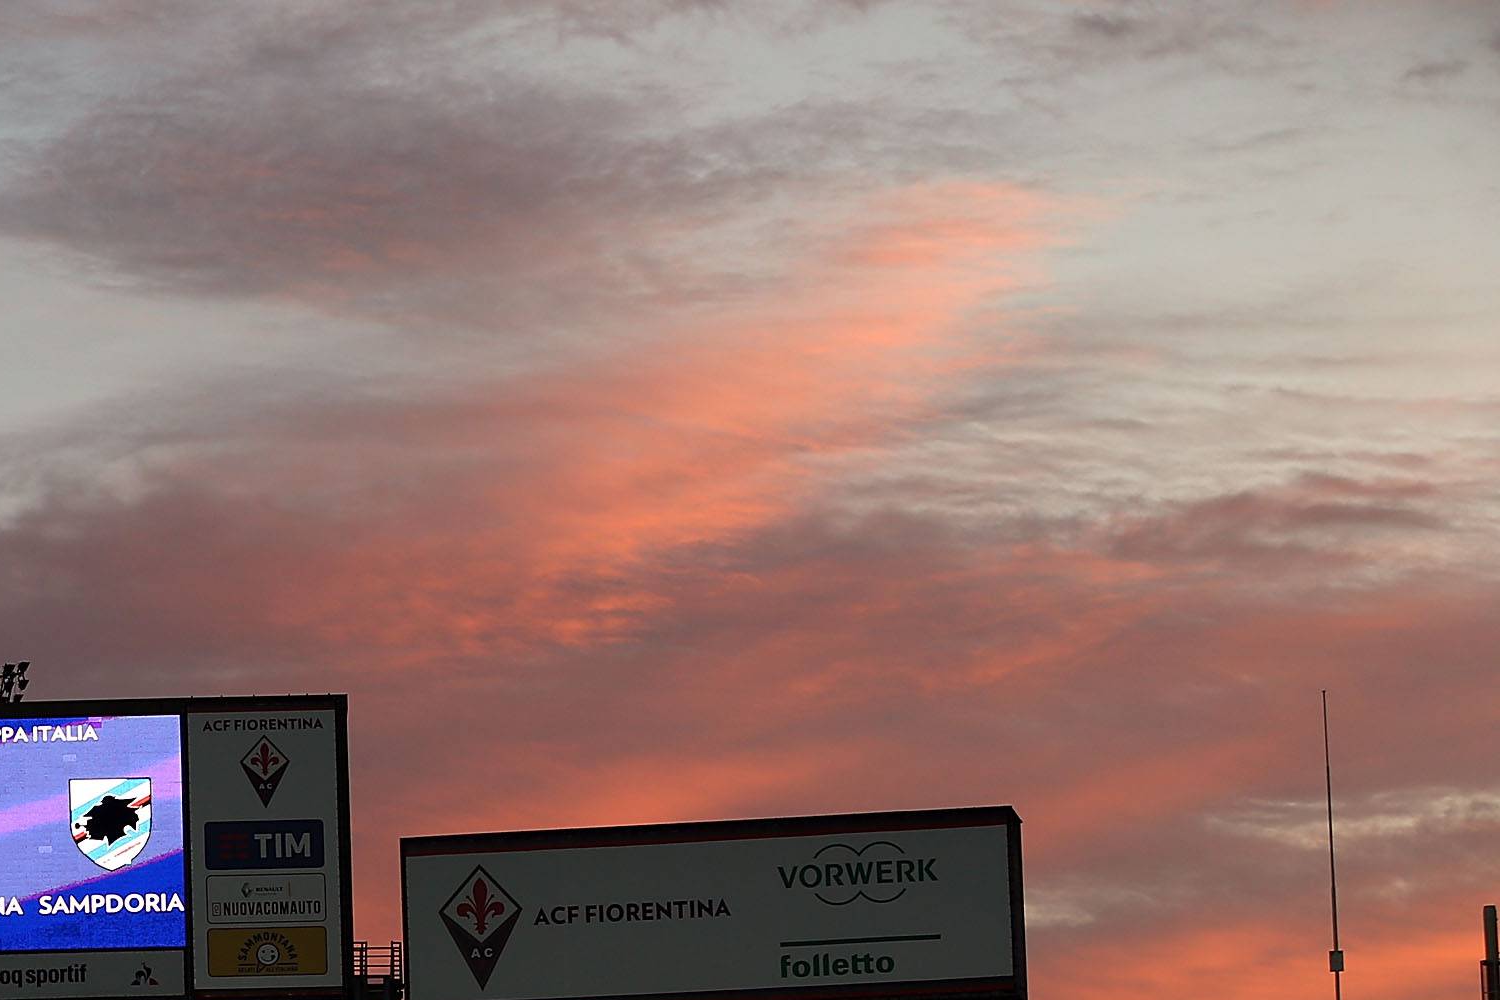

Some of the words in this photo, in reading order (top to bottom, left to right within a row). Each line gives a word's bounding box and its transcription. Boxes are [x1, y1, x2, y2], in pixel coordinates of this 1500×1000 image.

[32, 724, 98, 742] ITALIA
[203, 720, 231, 732] ACF
[234, 718, 323, 731] FIORENTINA
[253, 832, 312, 858] TIM
[777, 858, 939, 889] VORWERK
[38, 892, 185, 915] SAMPDORIA
[223, 901, 321, 916] NUOVACOMAUTO
[533, 906, 579, 926] ACF
[585, 899, 731, 923] FIORENTINA
[238, 931, 298, 961] SAMMONTANA
[25, 964, 87, 988] sportif
[780, 953, 895, 978] folletto
